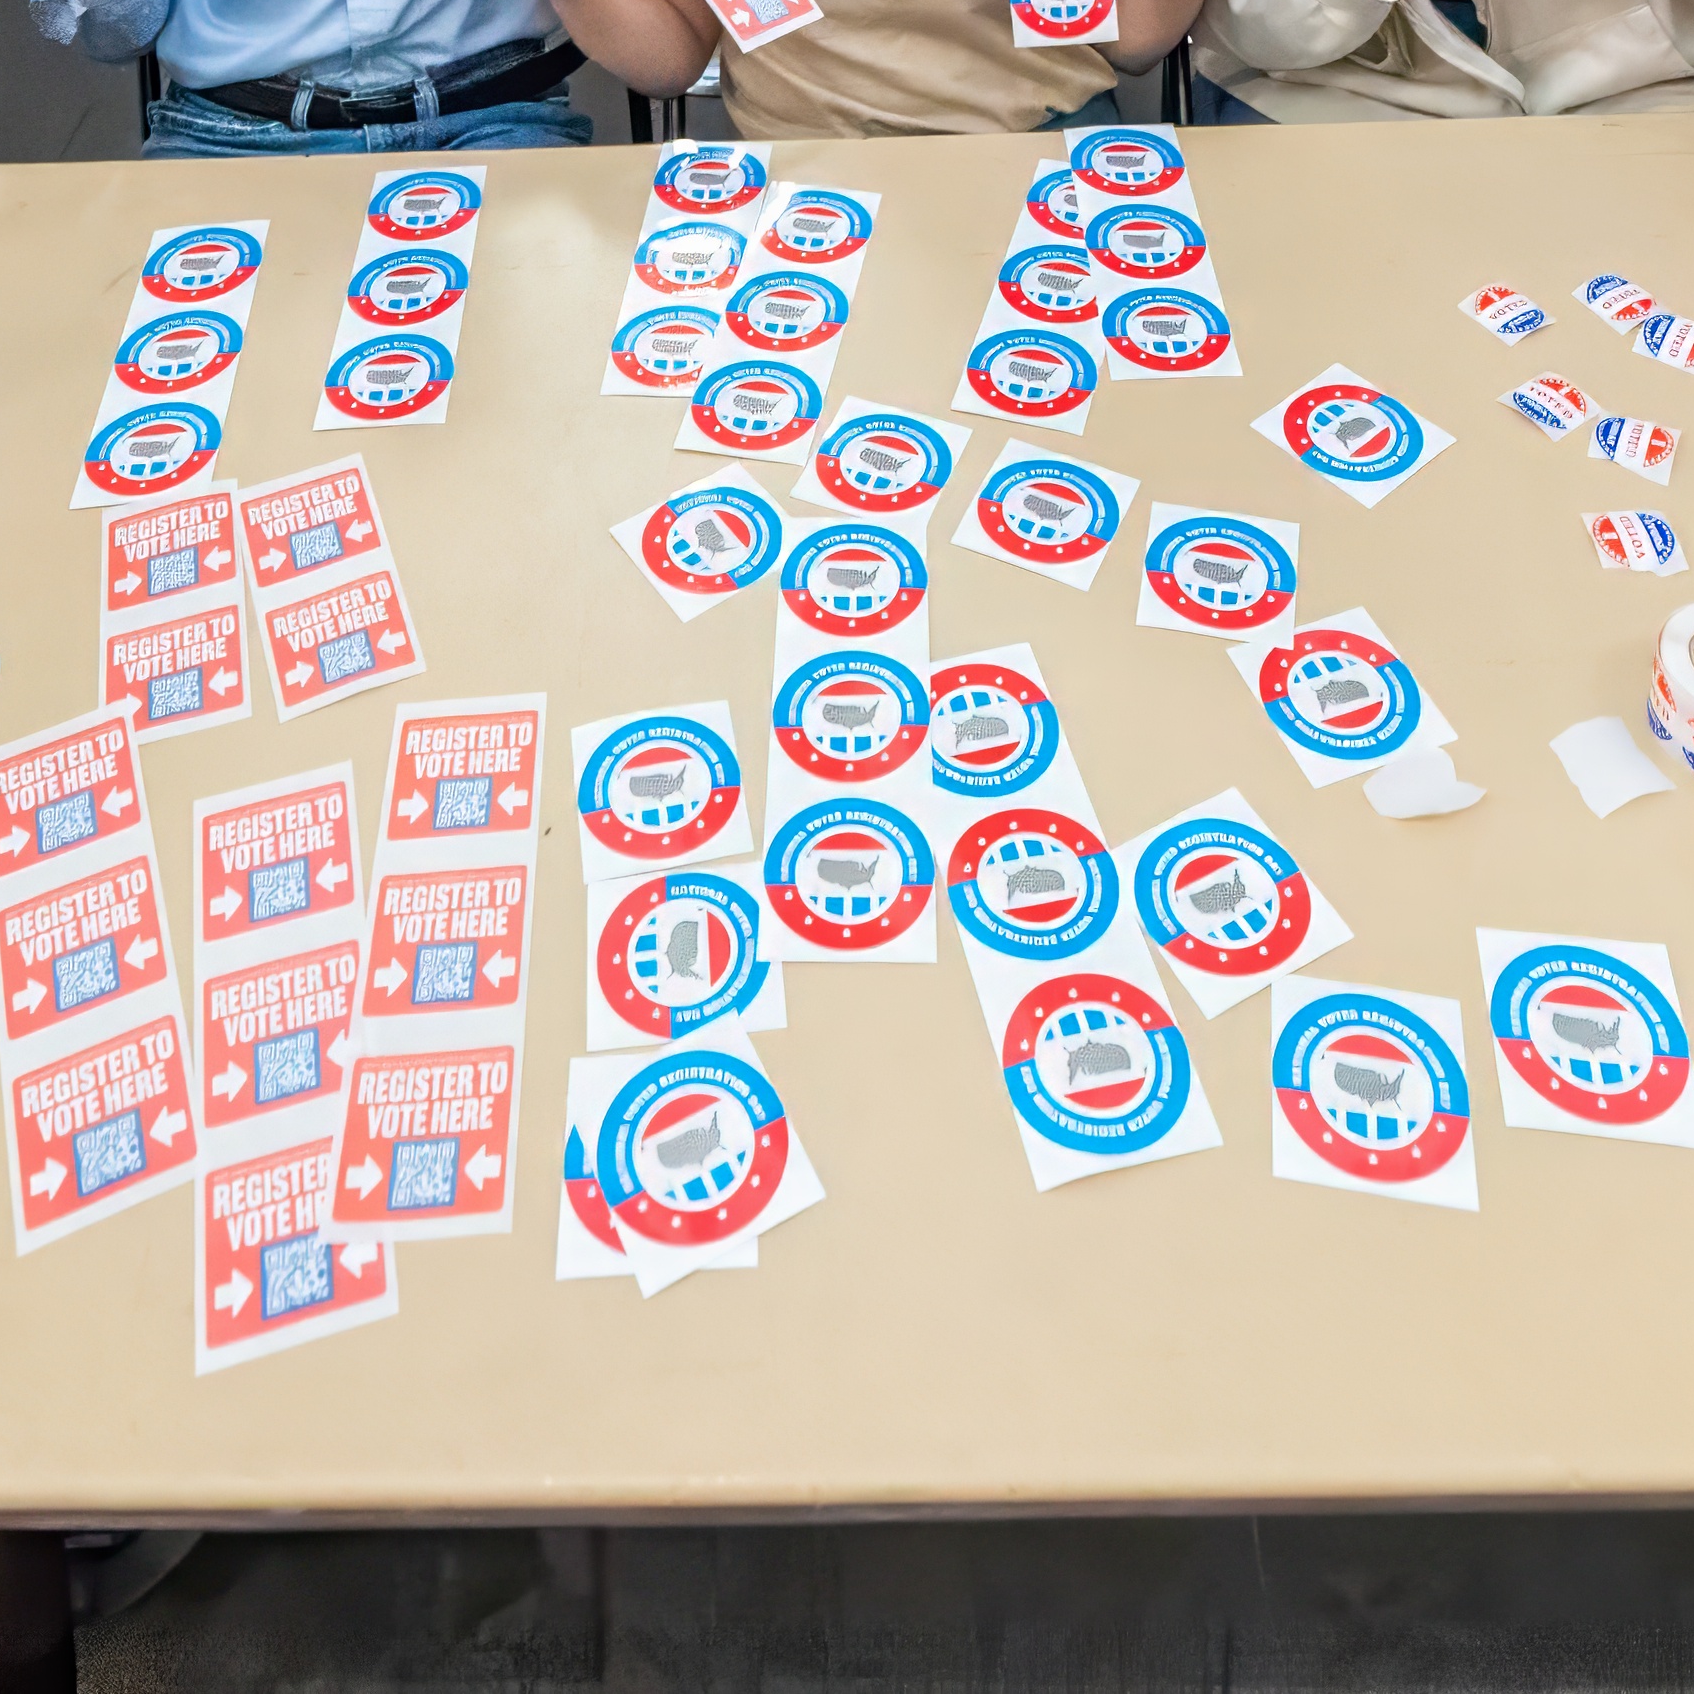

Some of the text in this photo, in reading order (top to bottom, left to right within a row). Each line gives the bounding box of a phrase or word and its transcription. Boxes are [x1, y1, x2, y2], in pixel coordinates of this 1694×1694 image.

[115, 500, 229, 546] REGISTER TO
[248, 474, 360, 526] REGISTER TO
[262, 495, 357, 540] VOTE HERE
[124, 519, 221, 563] VOTE HERE
[274, 578, 392, 638] REGISTER TO
[286, 602, 390, 653] VOTE HERE
[113, 613, 236, 666] REGISTER TO
[124, 637, 227, 683] VOTE HERE
[94, 729, 124, 759] TO
[406, 721, 532, 755] REGISTER TO
[414, 746, 521, 778] VOTE HERE
[6, 752, 119, 814] VOTE HERE
[209, 794, 343, 852] REGISTER TO
[221, 821, 335, 874] VOTE HERE
[6, 867, 148, 945] REGISTER TO
[383, 876, 521, 916] REGISTER TO
[20, 895, 142, 966] VOTE HERE
[393, 905, 508, 944] VOTE HERE
[211, 952, 356, 1021] REGISTER TO
[223, 986, 348, 1048] VOTE HERE
[21, 1027, 175, 1118] REGISTER TO
[357, 1059, 507, 1105] REGISTER TO
[37, 1061, 169, 1142] VOTE HERE
[367, 1095, 494, 1140] VOTE HERE
[225, 1201, 290, 1252] VOTE
